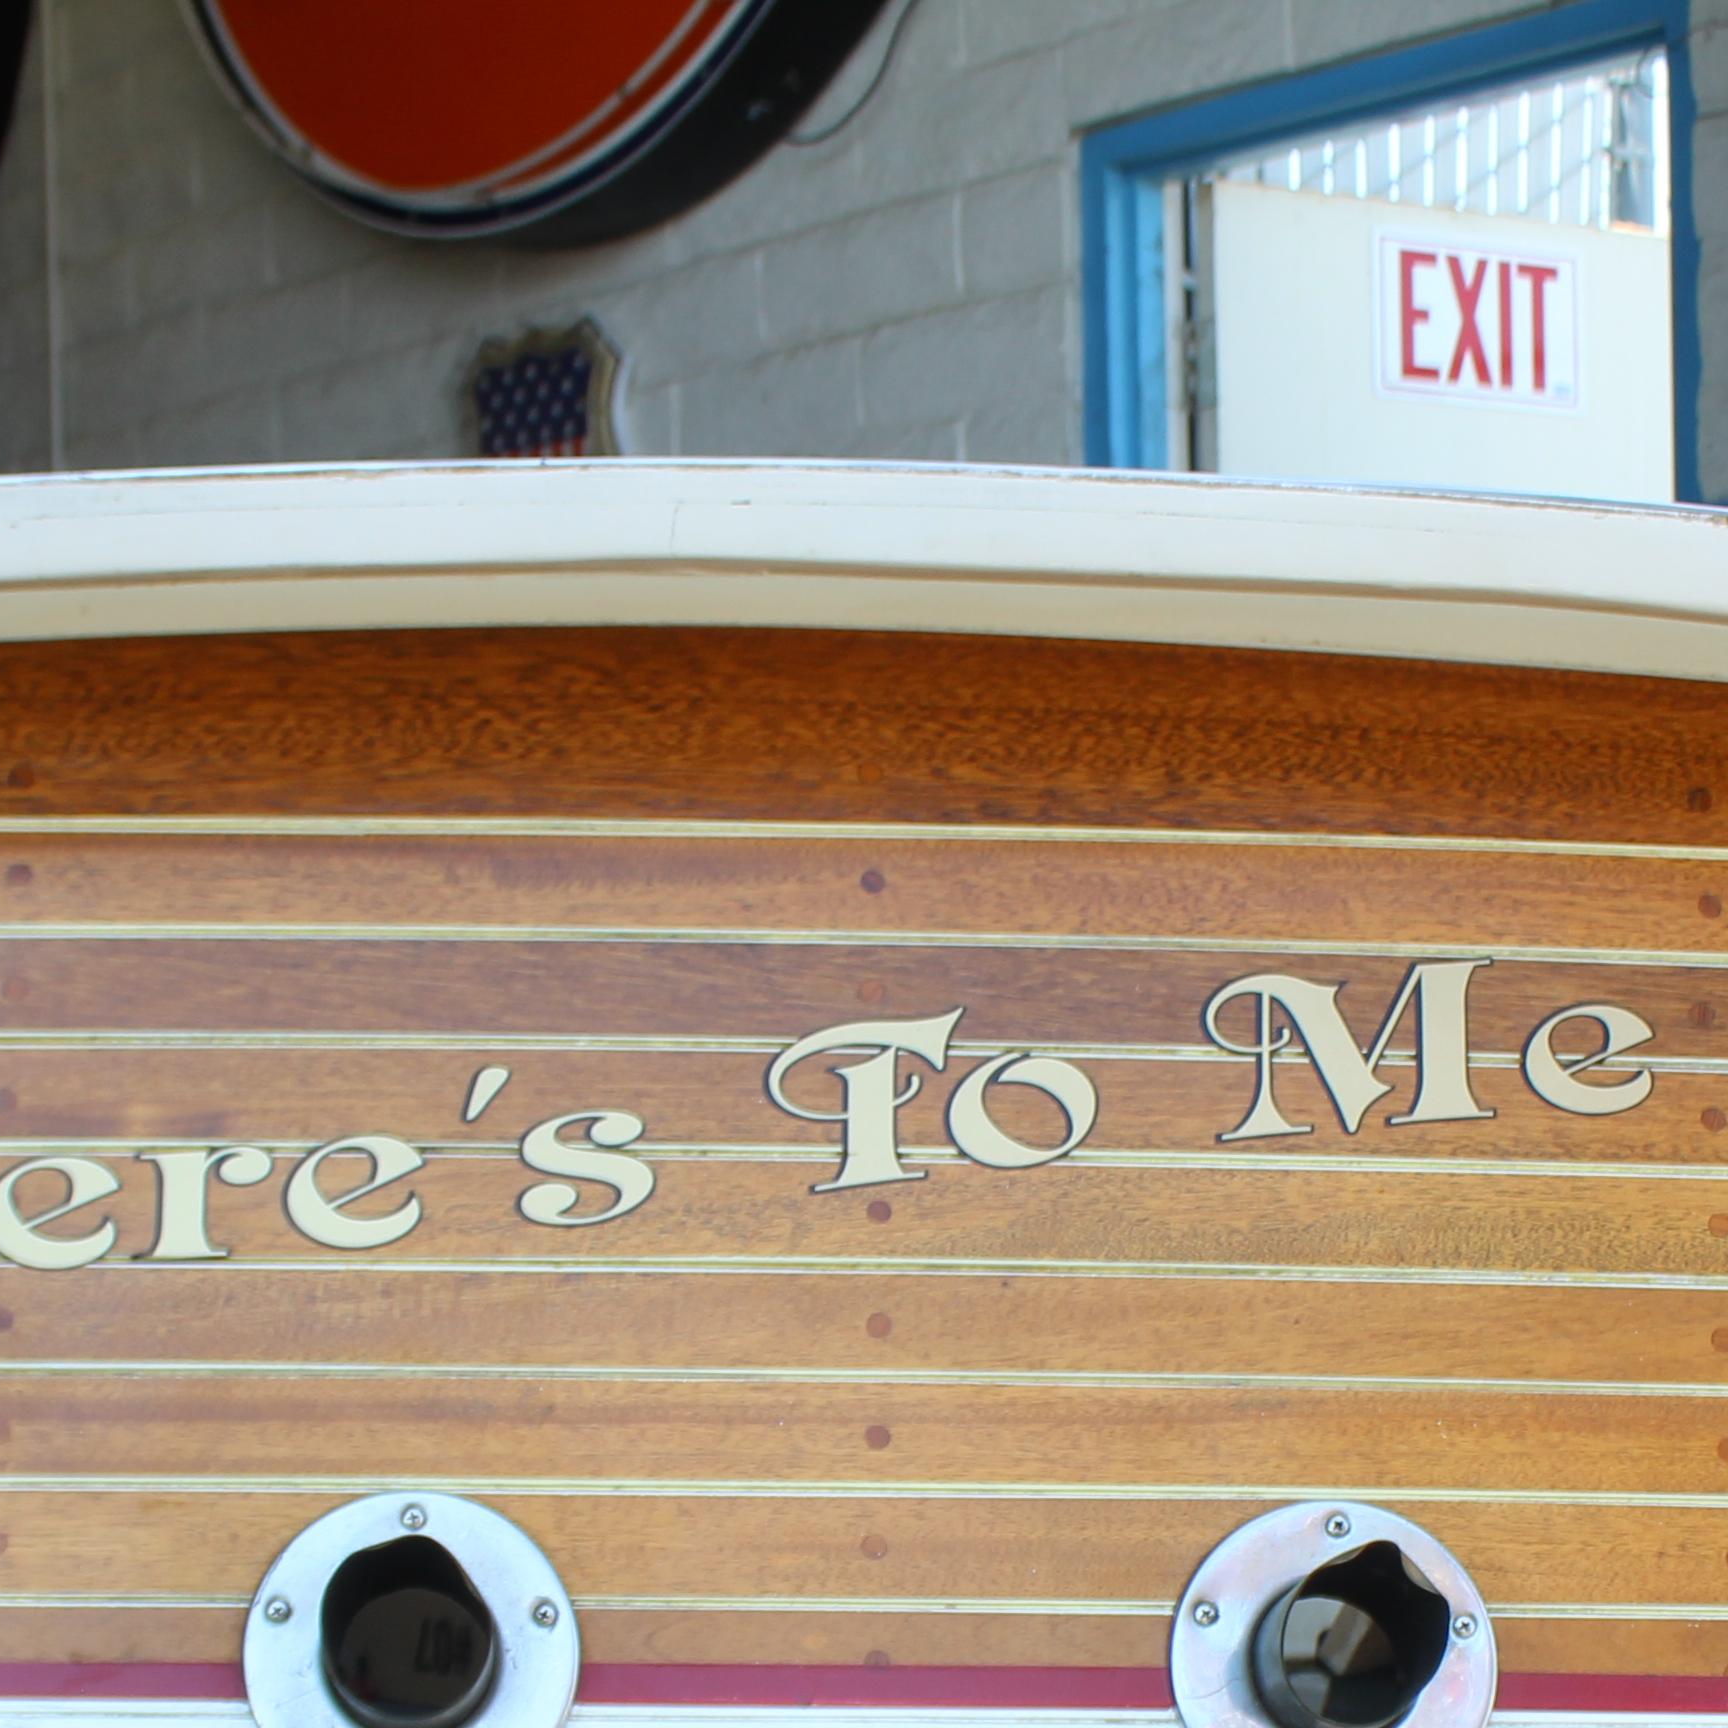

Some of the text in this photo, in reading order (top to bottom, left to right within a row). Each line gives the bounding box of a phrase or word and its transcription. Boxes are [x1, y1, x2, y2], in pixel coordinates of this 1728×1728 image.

[1399, 248, 1558, 392] EXIT
[766, 1005, 1100, 1192] To
[1200, 954, 1656, 1142] Me
